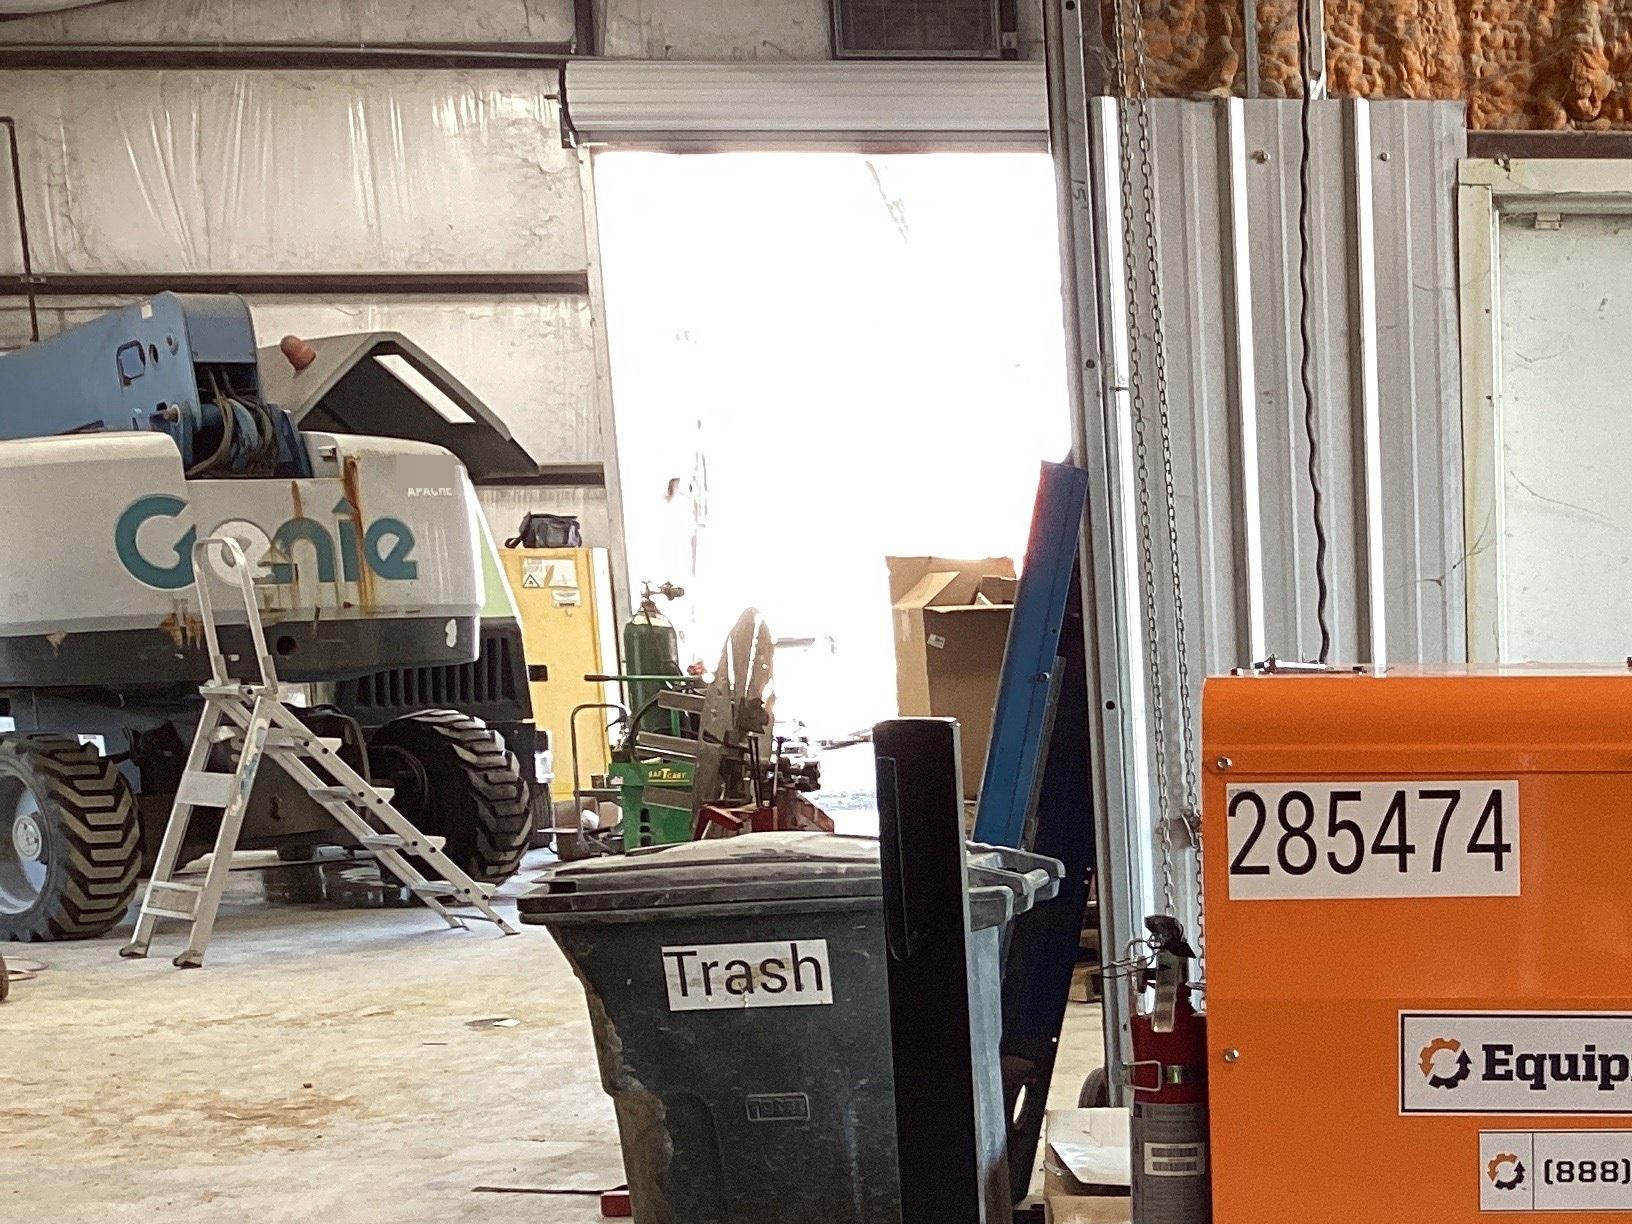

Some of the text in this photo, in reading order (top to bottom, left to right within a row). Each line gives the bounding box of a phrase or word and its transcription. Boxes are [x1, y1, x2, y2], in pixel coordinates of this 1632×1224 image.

[1228, 789, 1512, 876] 285474
[663, 942, 824, 998] Trash
[1543, 1158, 1632, 1185] (888)
